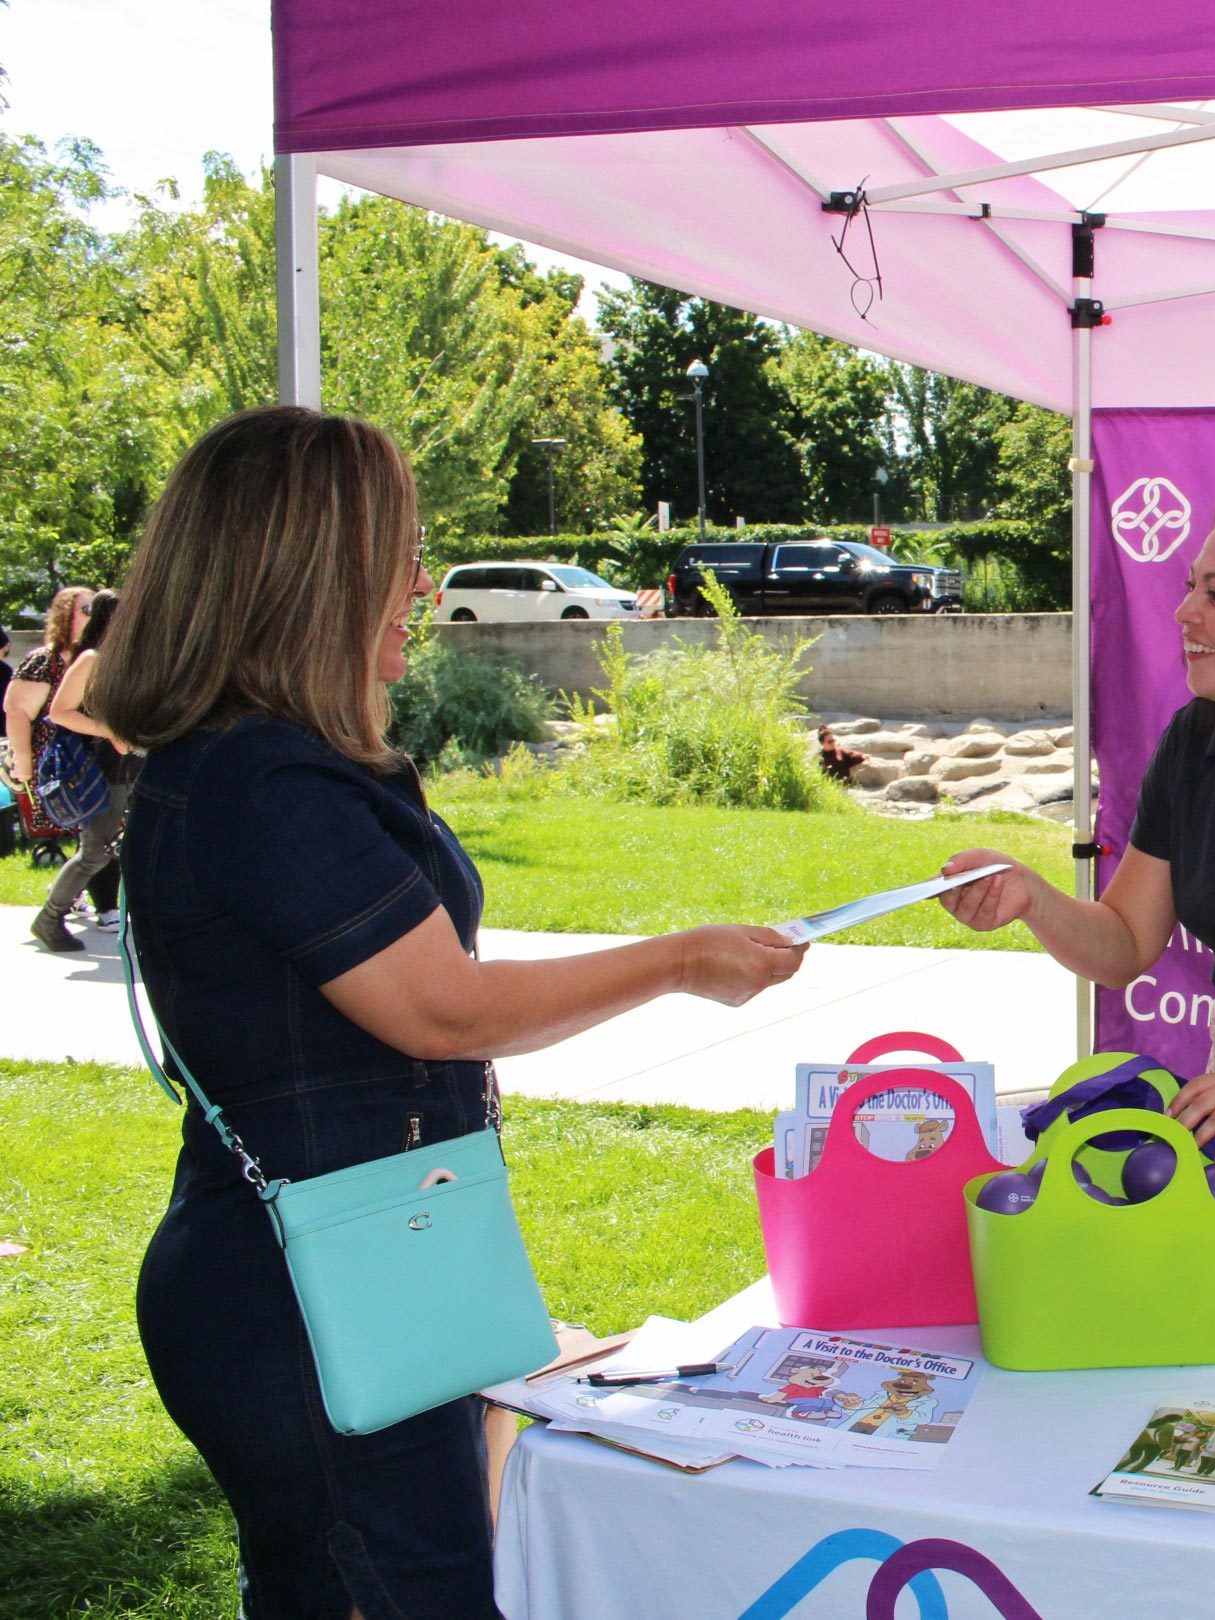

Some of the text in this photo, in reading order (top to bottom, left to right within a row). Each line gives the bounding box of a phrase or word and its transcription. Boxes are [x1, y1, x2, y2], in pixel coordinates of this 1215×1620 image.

[803, 1339, 813, 1350] A
[814, 1340, 840, 1354] Visit
[840, 1346, 853, 1357] to
[854, 1349, 874, 1361] the
[874, 1351, 921, 1369] Doctor's
[923, 1359, 958, 1376] Office
[768, 1428, 801, 1440] health
[1120, 1479, 1170, 1490] Resource
[1173, 1485, 1206, 1494] Guide
